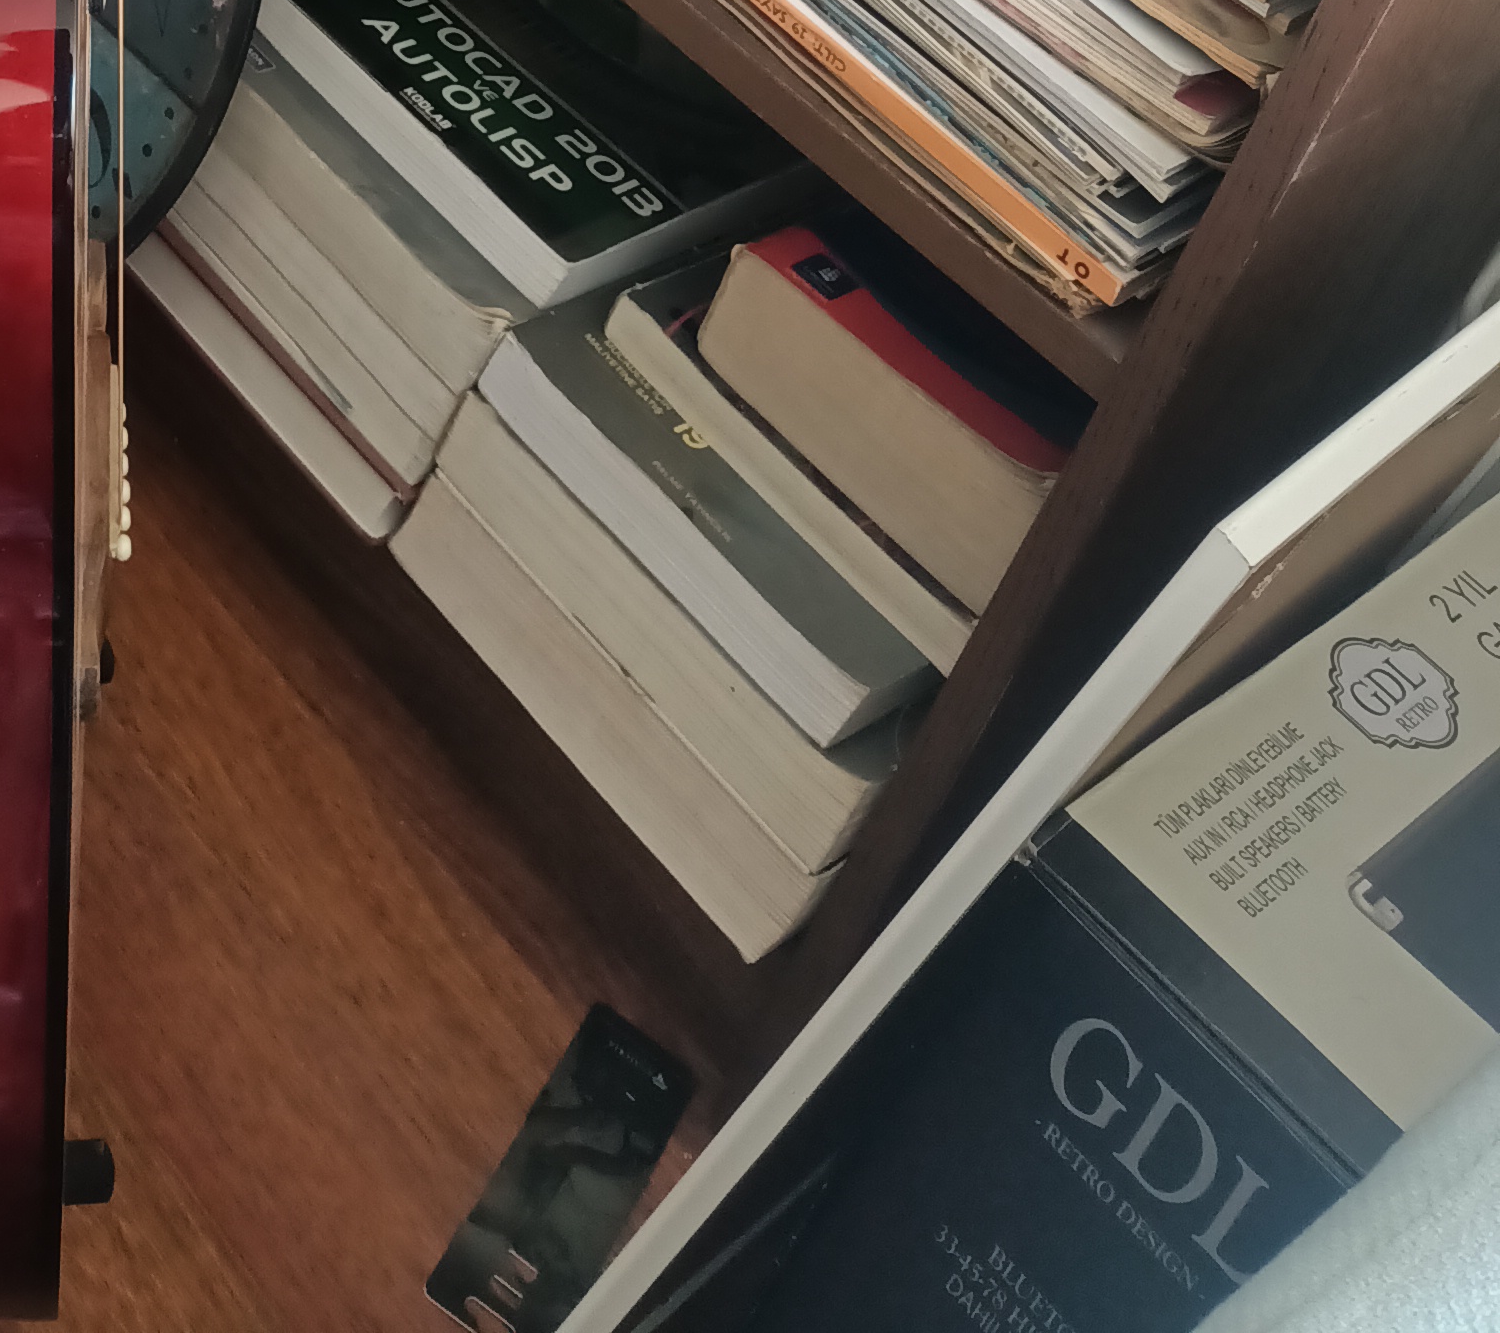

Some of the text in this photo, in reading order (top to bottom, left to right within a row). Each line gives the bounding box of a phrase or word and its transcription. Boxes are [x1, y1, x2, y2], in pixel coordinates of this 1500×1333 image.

[360, 18, 574, 193] AUTOLISP
[402, 86, 453, 131] KODLAB
[471, 79, 500, 103] VE
[553, 128, 665, 218] 2013
[1428, 569, 1499, 624] 2 YIL
[1350, 657, 1427, 717] GDL
[1395, 694, 1440, 734] RETRO
[1225, 721, 1306, 787] DİNLEYEBİLME
[1182, 734, 1346, 867] AUX HEADPHONE JACK
[1208, 776, 1349, 893] BUILT SPEAKERS BATTERY
[1236, 856, 1310, 919] BLUETOOTH
[1050, 1018, 1270, 1284] GDL
[1041, 1122, 1197, 1292] RETRO DESIGN
